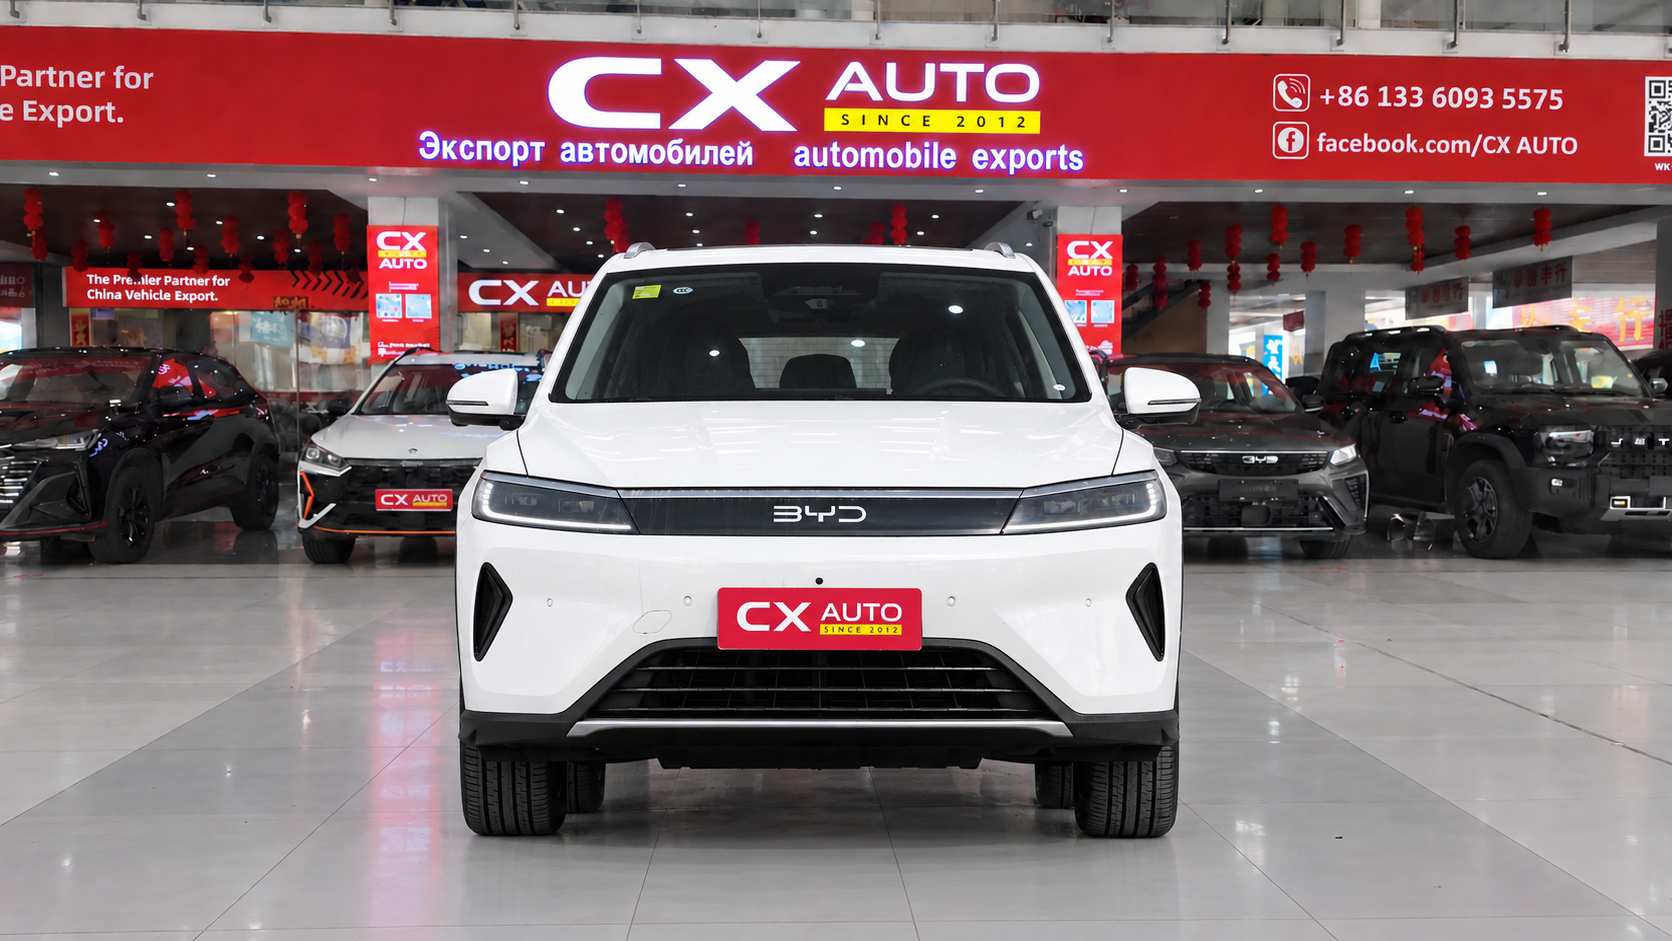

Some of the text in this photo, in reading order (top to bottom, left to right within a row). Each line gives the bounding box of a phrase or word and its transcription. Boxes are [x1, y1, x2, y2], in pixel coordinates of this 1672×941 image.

[0, 65, 154, 90] Partner for
[826, 62, 1041, 104] AUTO
[547, 56, 800, 132] CX
[1320, 85, 1563, 110] +86 133 6093 5575
[23, 101, 124, 128] Export.
[841, 113, 1026, 128] SINCE 2012
[419, 131, 754, 168] Экспорт автомобилей
[1317, 132, 1579, 158] facebook.com/CX AUTO
[794, 141, 1084, 175] automobile exports
[376, 231, 427, 250] CX
[1066, 240, 1113, 259] CX
[379, 258, 428, 270] AUTO
[1067, 265, 1112, 277] AUTO
[87, 274, 110, 285] The
[164, 276, 210, 286] Partner
[212, 275, 231, 286] for
[547, 280, 592, 298] AU
[87, 289, 219, 303] China Vehicle Export.
[468, 279, 540, 306] CX
[380, 494, 408, 506] CX
[412, 493, 449, 503] AUTO
[773, 505, 867, 523] BYD
[736, 601, 811, 632] CX
[820, 603, 903, 622] AUTO
[824, 625, 898, 635] SINCE 2012
